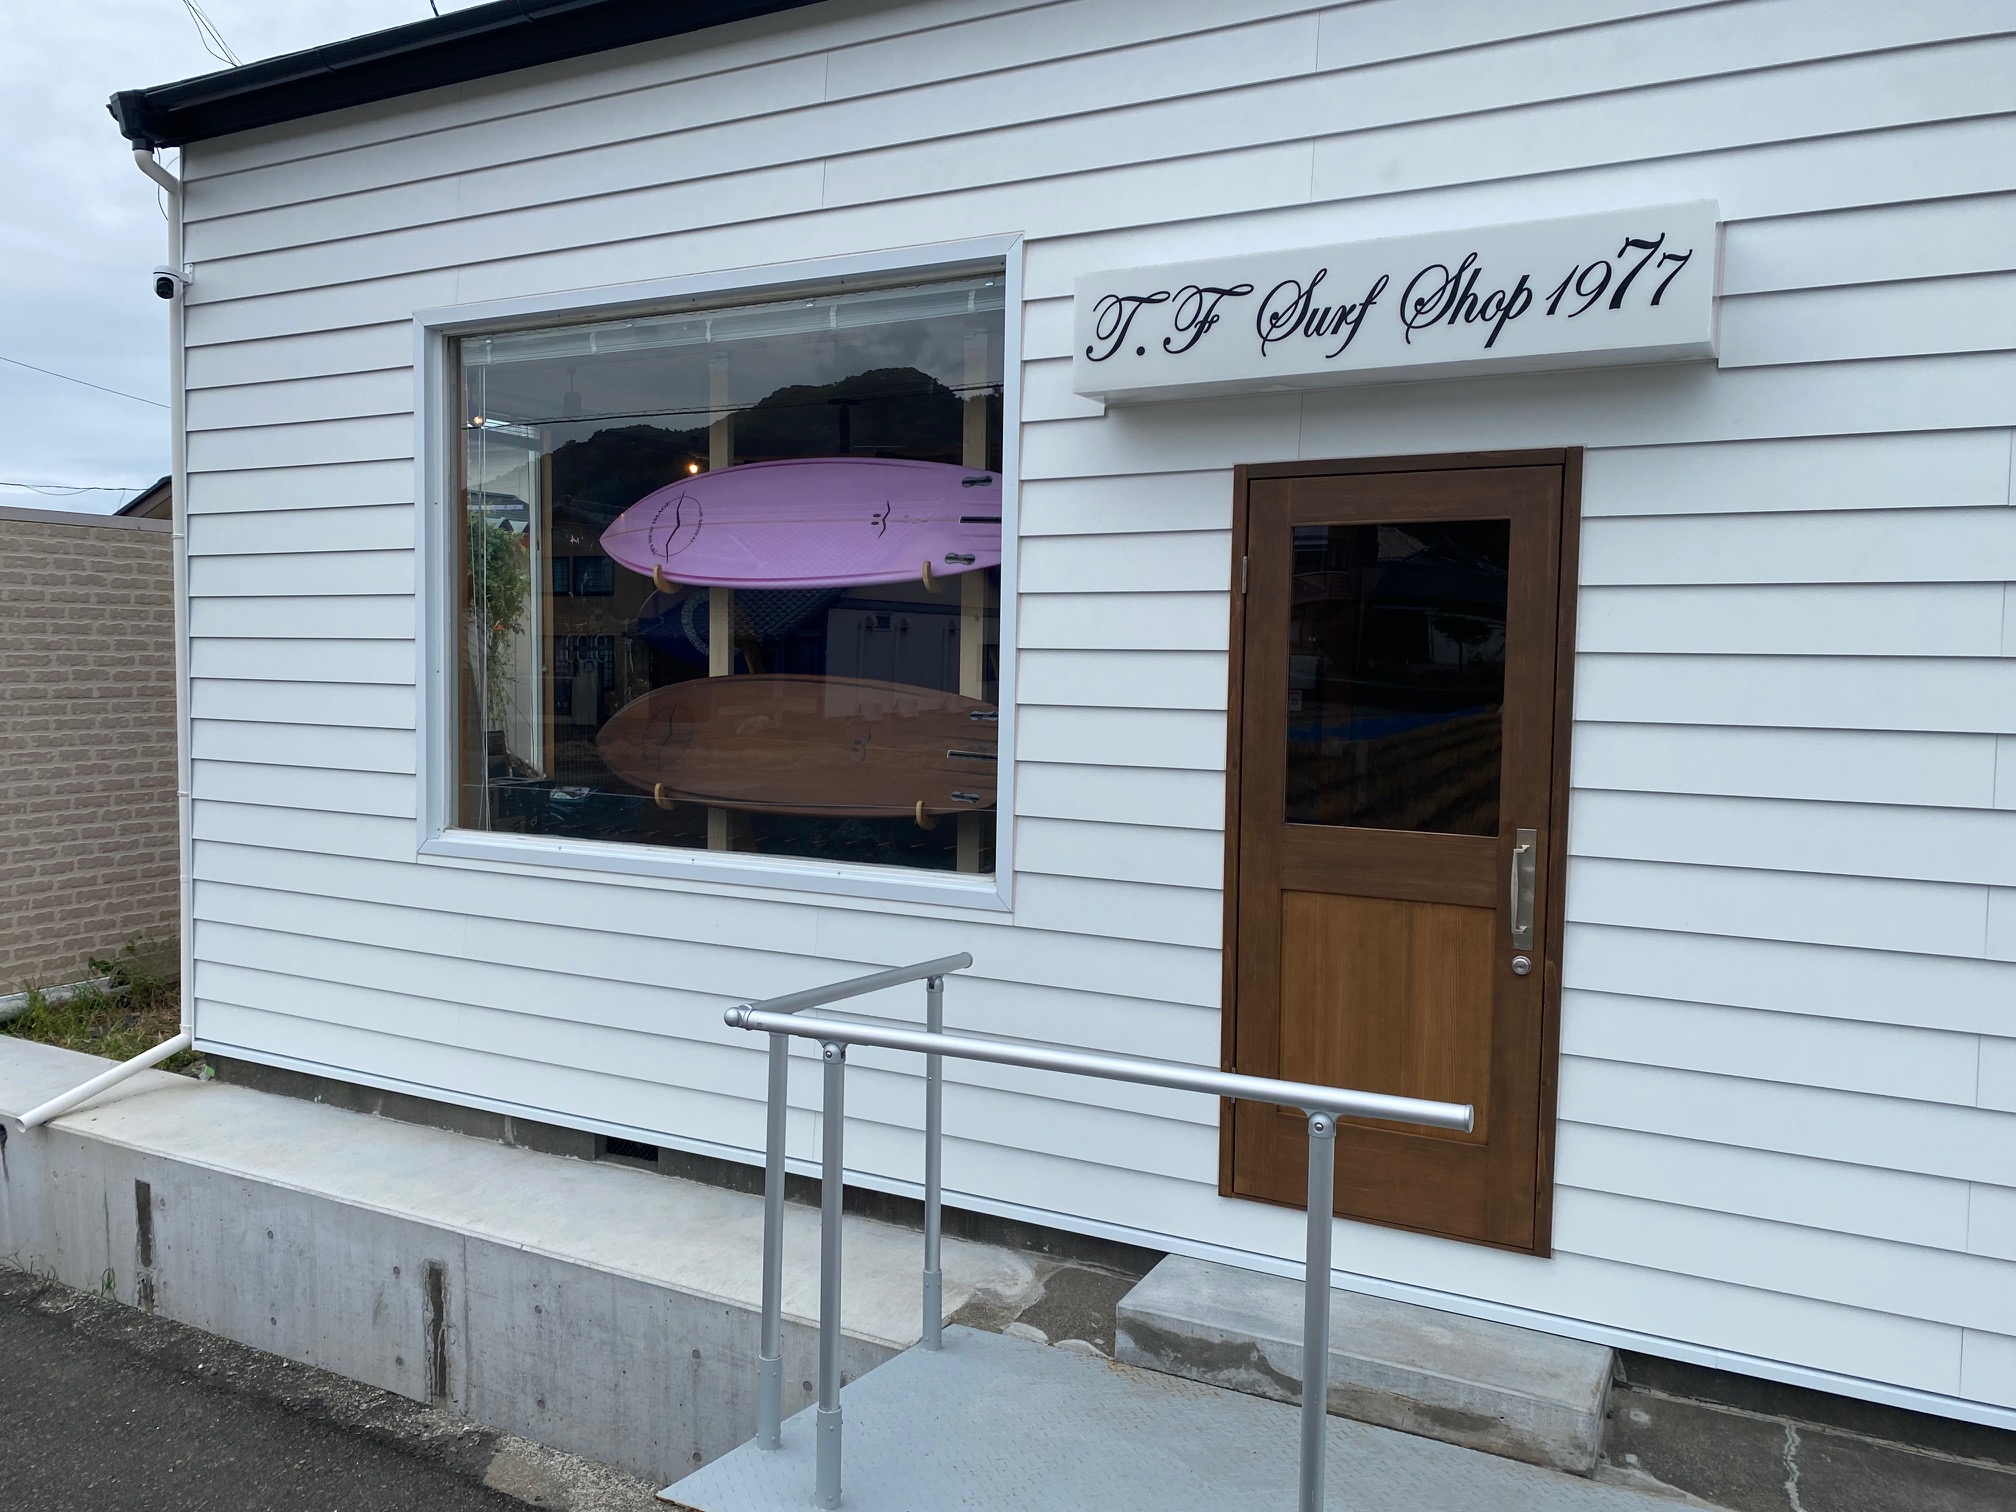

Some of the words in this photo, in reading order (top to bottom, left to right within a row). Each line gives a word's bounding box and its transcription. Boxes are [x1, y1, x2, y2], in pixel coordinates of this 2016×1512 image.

[1256, 267, 1390, 359] Surf
[1399, 251, 1533, 349] Shop
[1545, 232, 1693, 317] 1977
[652, 502, 670, 525] IMAGE
